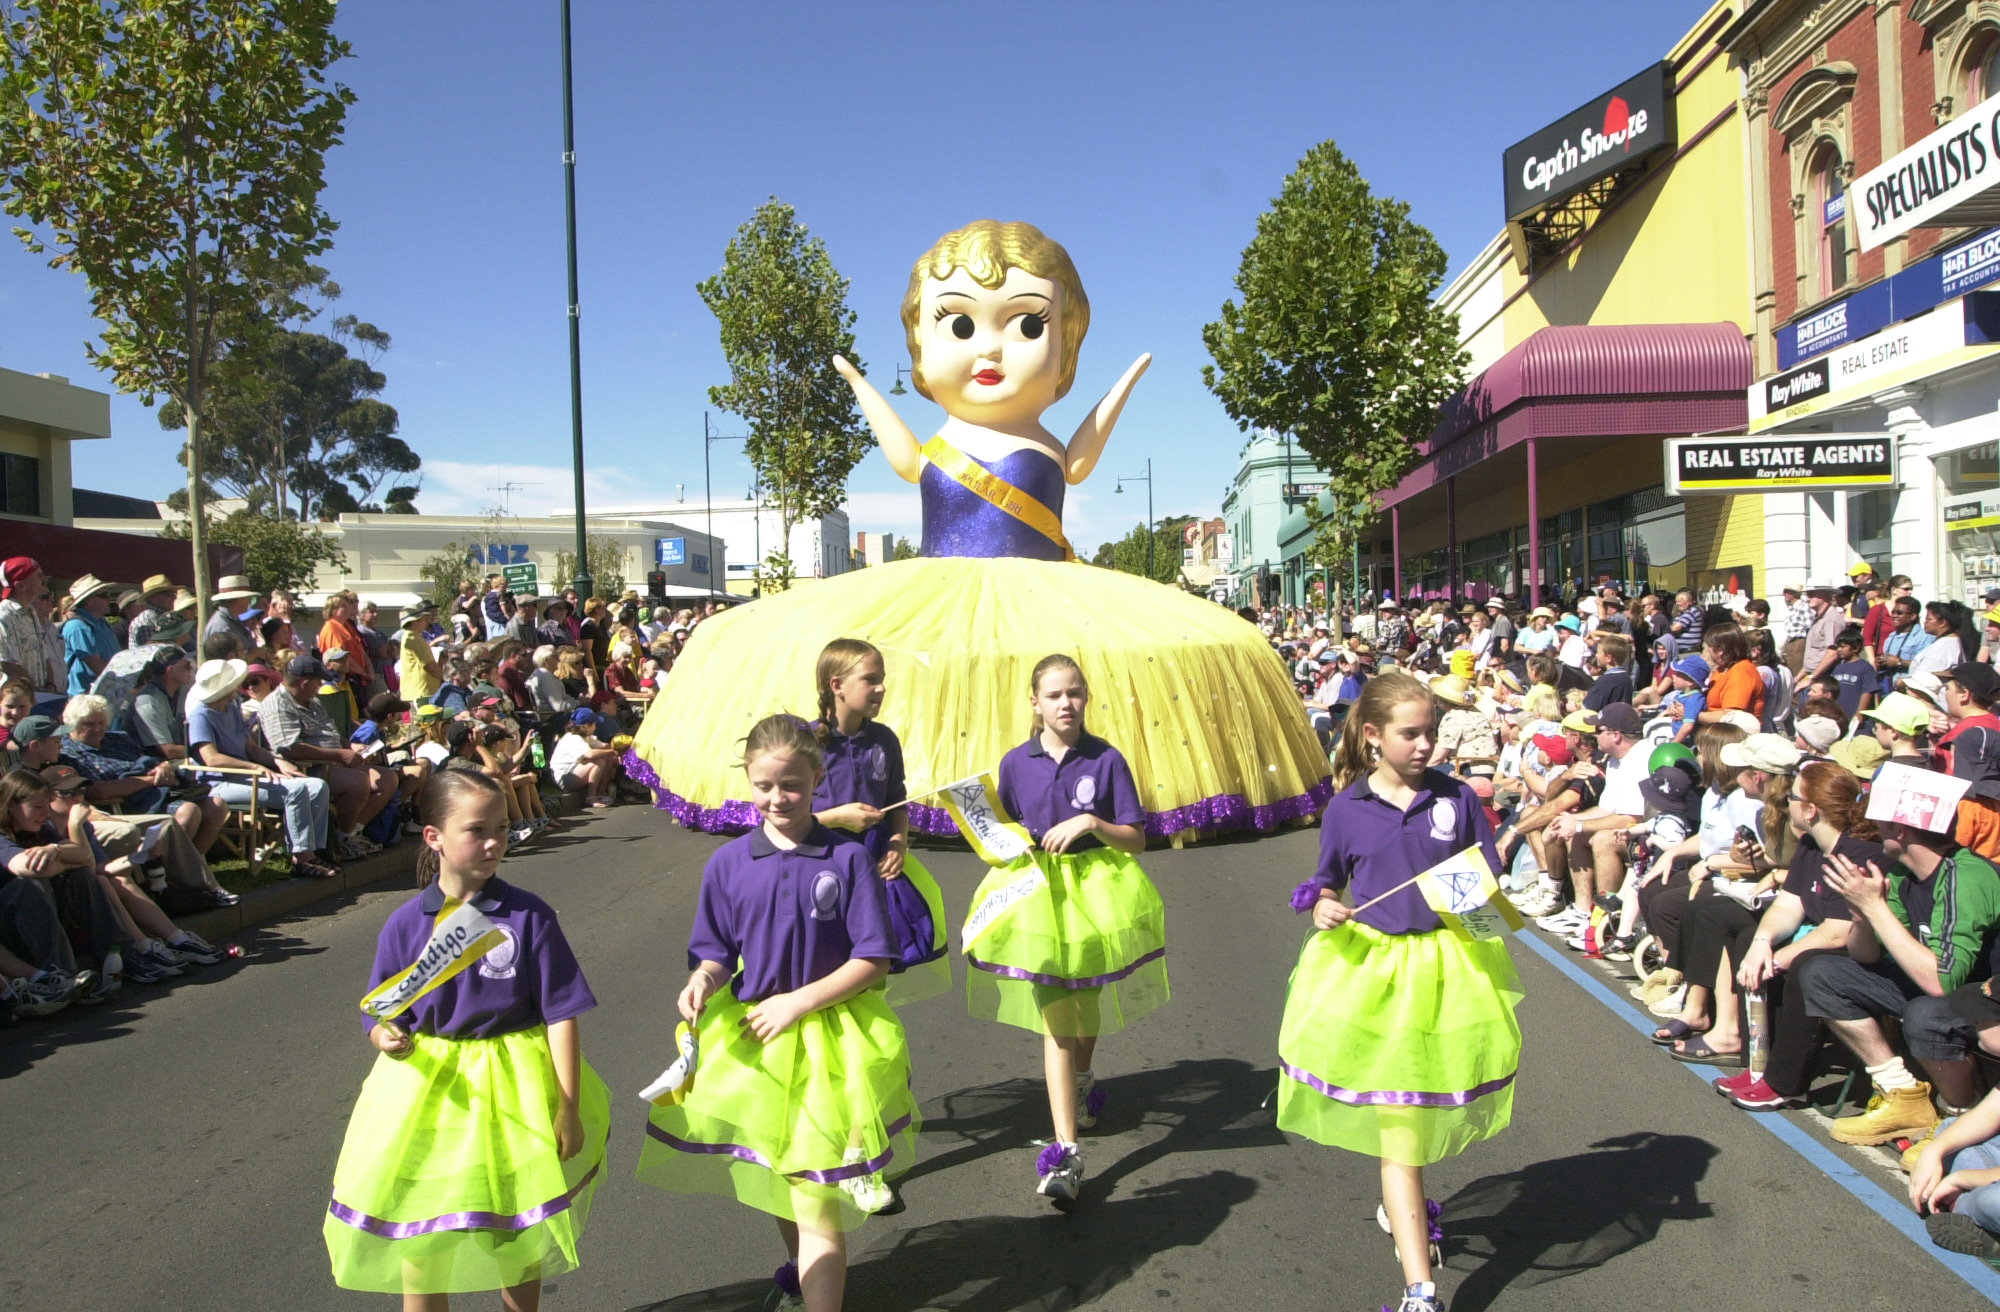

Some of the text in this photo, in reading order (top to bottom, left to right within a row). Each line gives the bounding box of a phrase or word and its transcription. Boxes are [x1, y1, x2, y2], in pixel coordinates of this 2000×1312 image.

[1523, 139, 1578, 192] Capt'n
[1866, 122, 1987, 231] SPECIALISTS
[1942, 252, 1967, 278] H&R
[1797, 308, 1847, 343] H&R BLOCK
[1842, 336, 1908, 376] REAL ESTATE
[1771, 371, 1822, 405] Ray White
[1685, 445, 1884, 468] REAL ESTATE AGENTS
[1756, 466, 1813, 479] Ray White
[466, 544, 529, 565] ANZ
